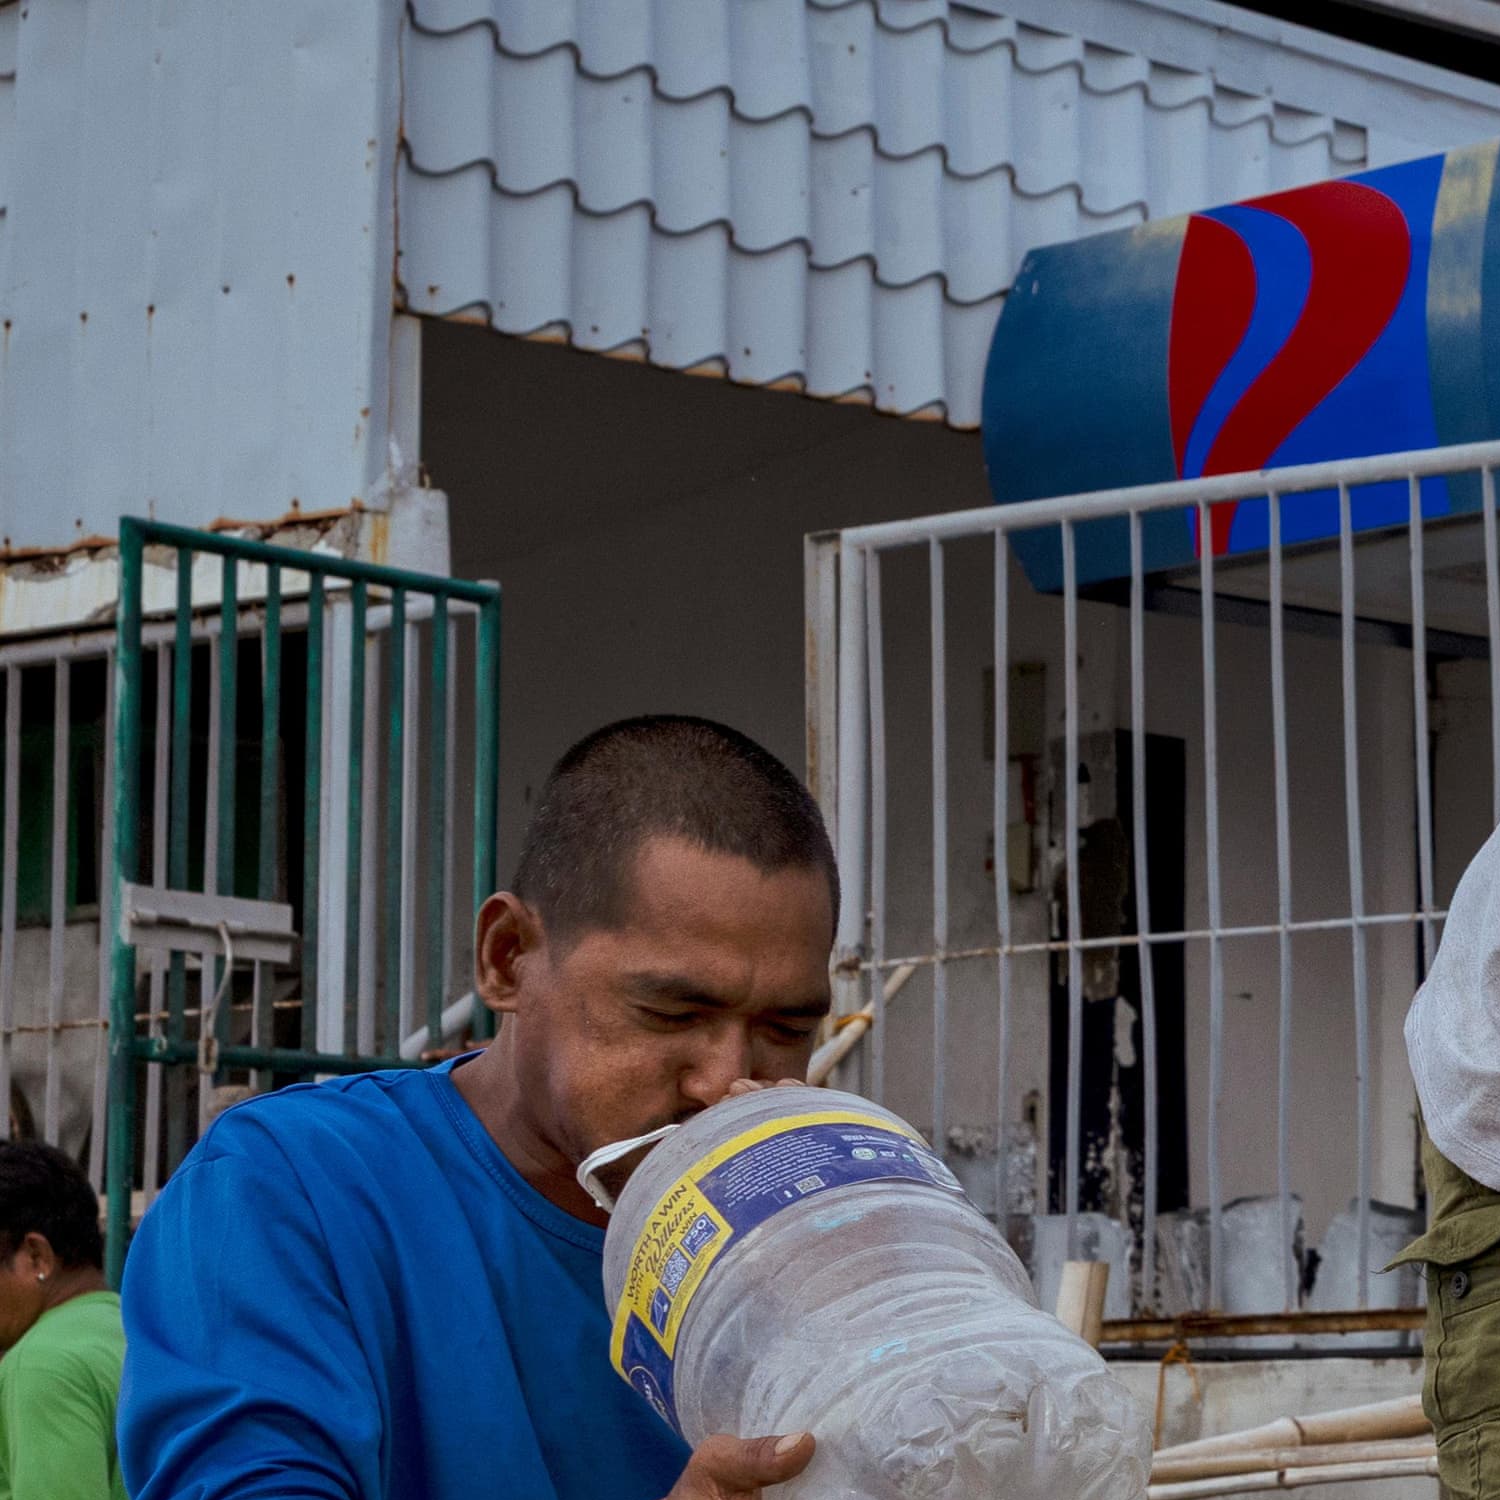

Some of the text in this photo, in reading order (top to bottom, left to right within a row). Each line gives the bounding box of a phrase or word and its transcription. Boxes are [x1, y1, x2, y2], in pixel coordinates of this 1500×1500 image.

[627, 1184, 688, 1298] WORTH A WIN
[644, 1198, 696, 1274] Wilkins
[655, 1242, 676, 1279] ENTER
[679, 1213, 698, 1235] WIN
